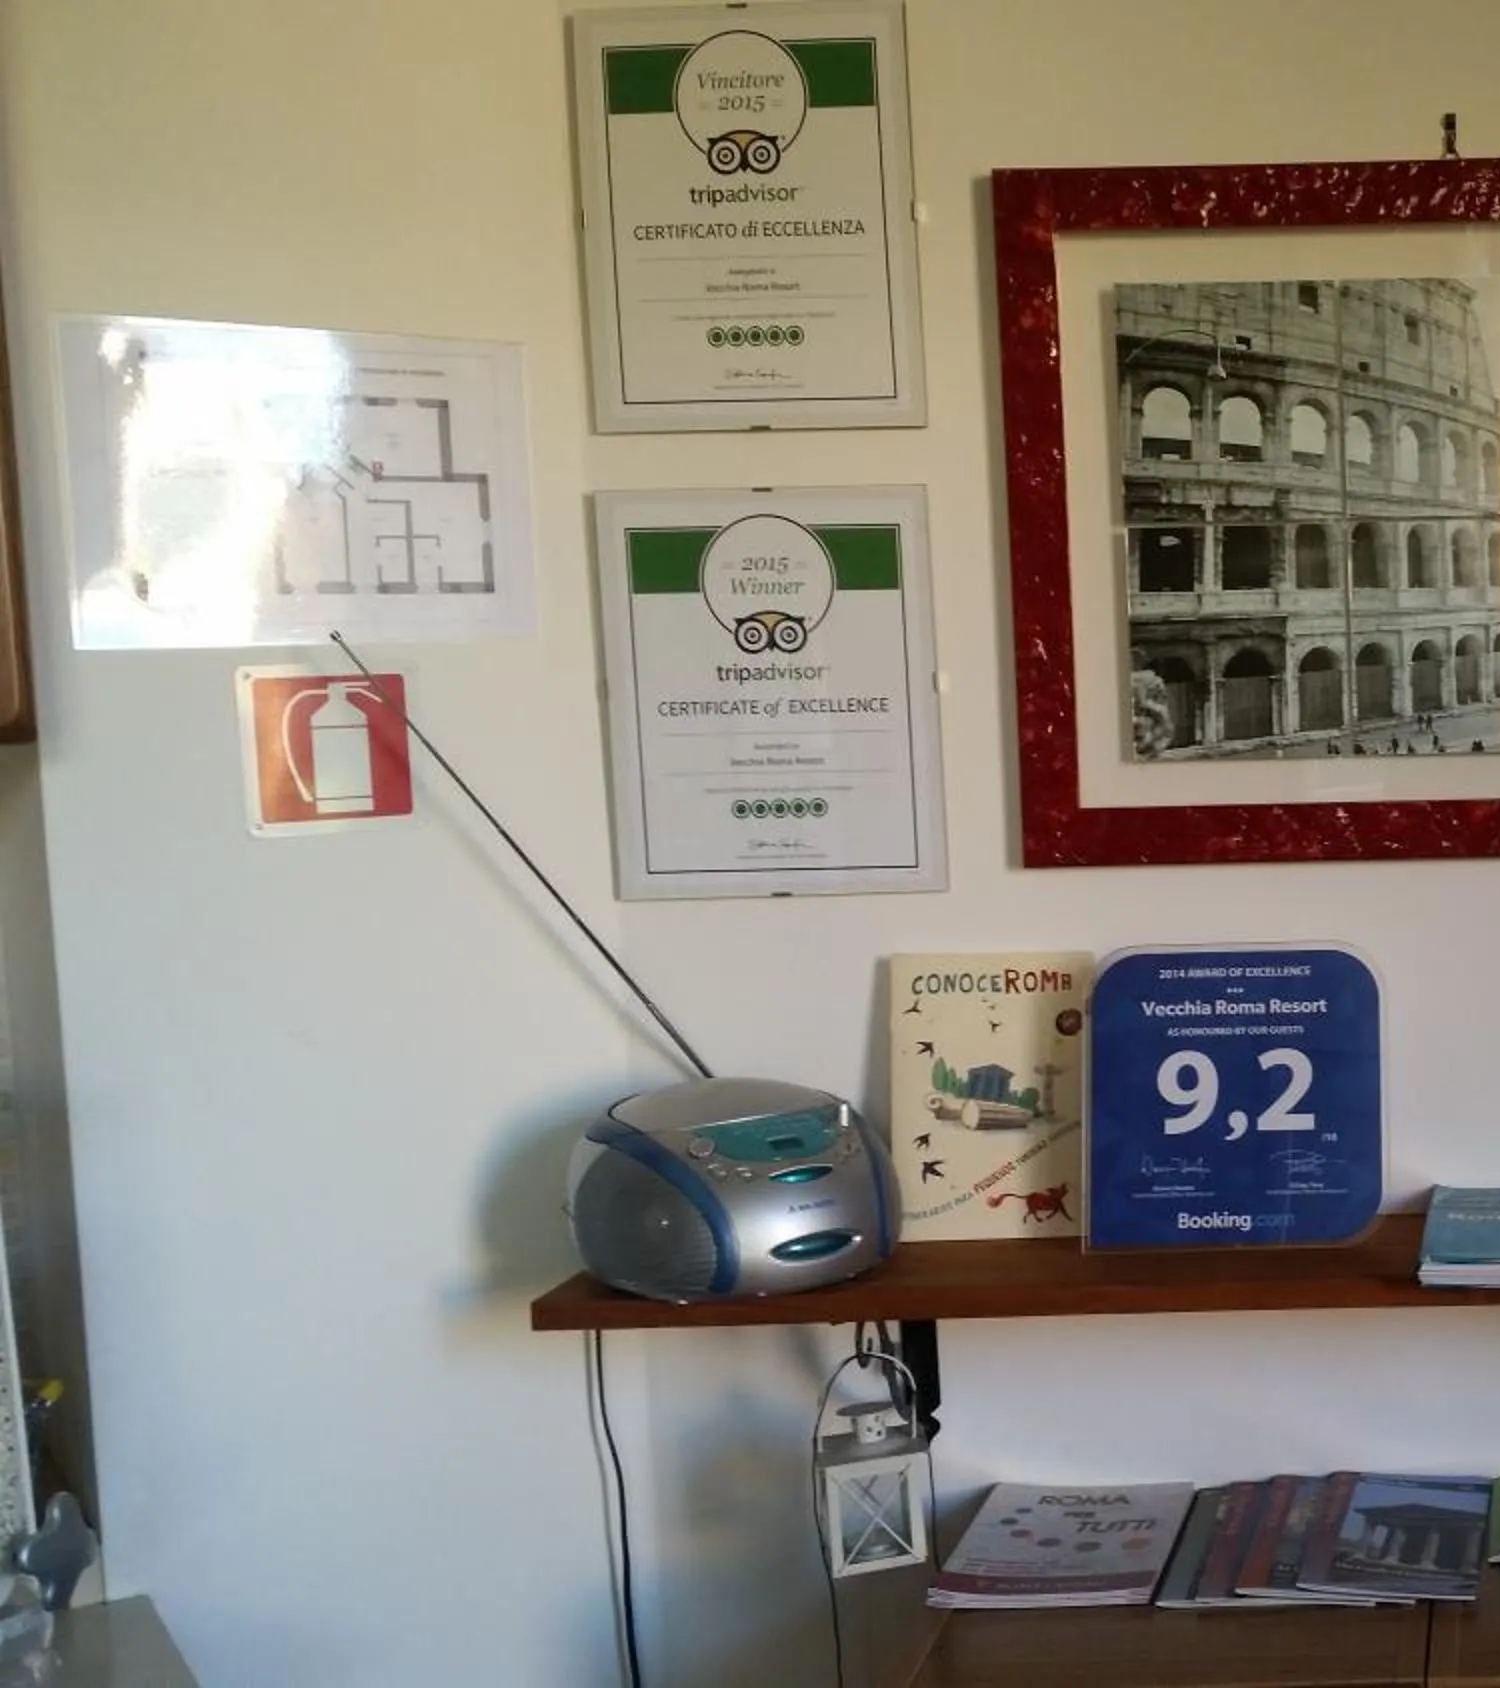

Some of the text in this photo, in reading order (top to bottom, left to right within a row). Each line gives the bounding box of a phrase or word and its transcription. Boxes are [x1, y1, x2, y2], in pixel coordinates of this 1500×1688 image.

[696, 72, 785, 91] Vincitore
[717, 95, 767, 114] 2015
[689, 184, 800, 208] tripadvisor
[633, 219, 865, 241] CERTIFICATO di ECCELLENZA
[741, 556, 790, 574] 2015
[729, 577, 806, 597] Winner
[716, 664, 824, 687] tripadvisor
[657, 697, 889, 719] CERTIFICATE of EXCELLENCE
[1158, 965, 1312, 980] 2014 AWARD OF EXCELLENCE
[1141, 998, 1329, 1018] Vecchia Roma Resort
[1156, 1047, 1316, 1141] 9,2
[1038, 1494, 1131, 1507] ROMA
[1074, 1519, 1158, 1533] TUTTI
